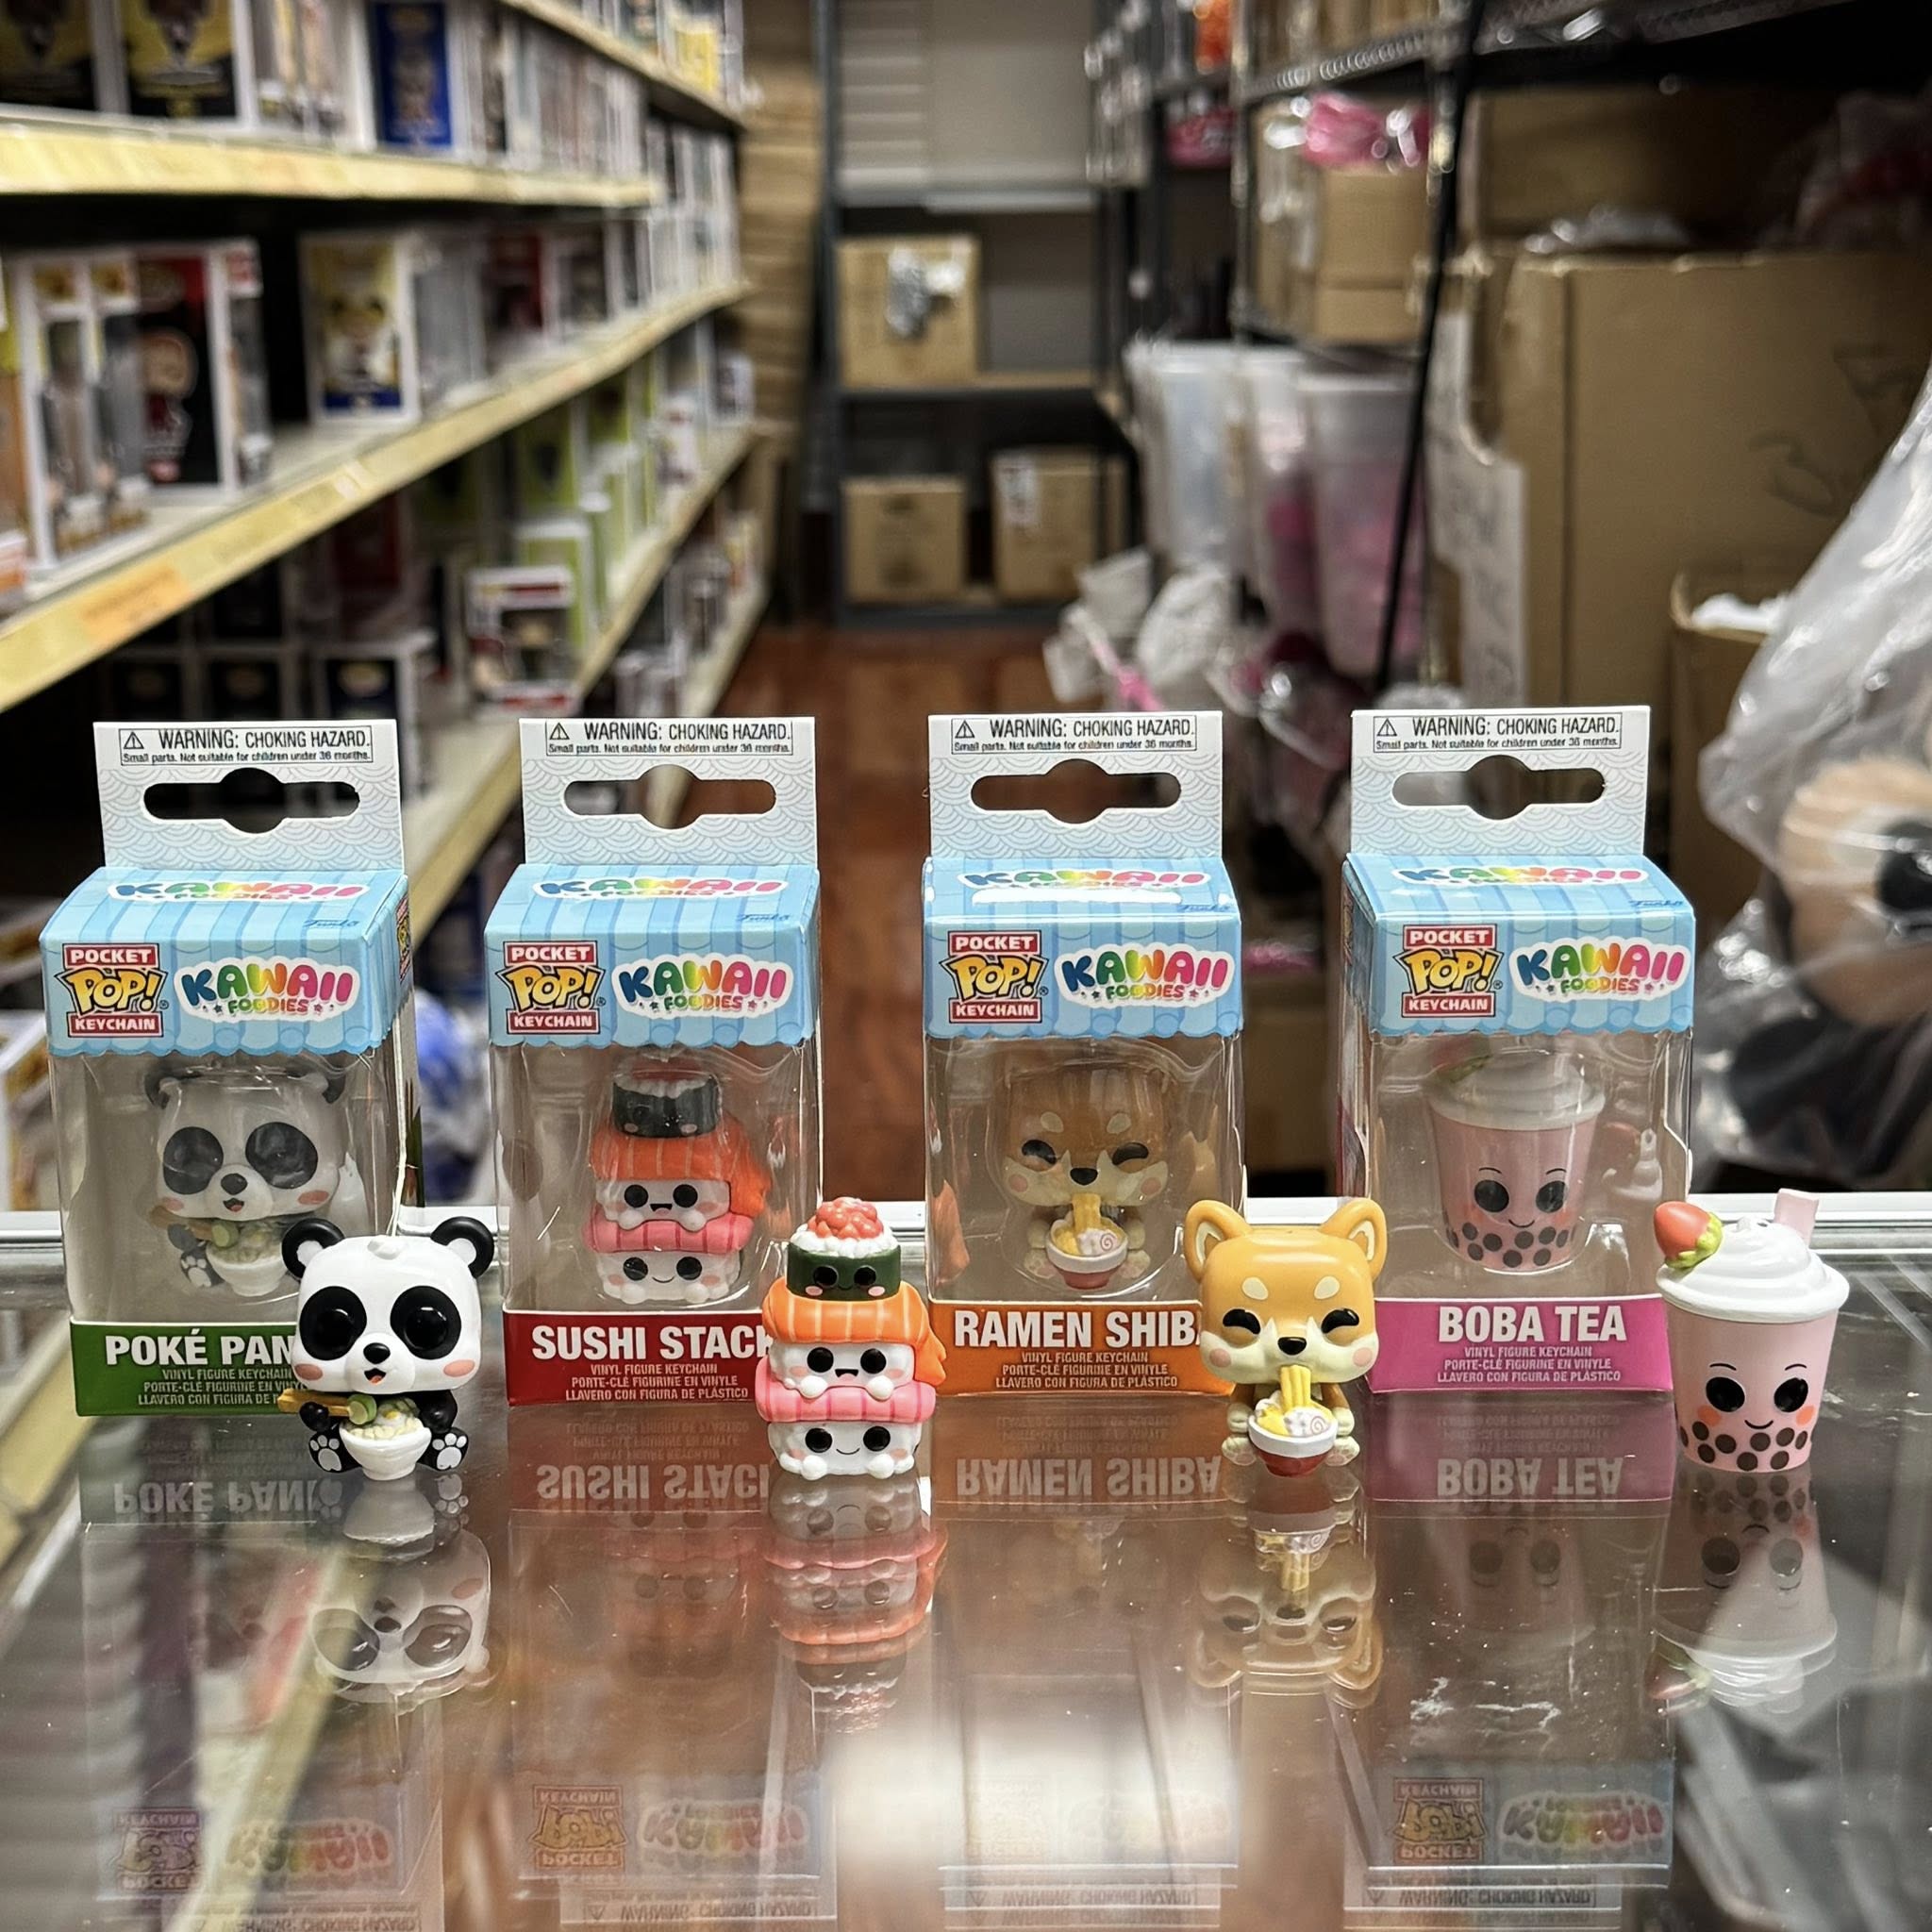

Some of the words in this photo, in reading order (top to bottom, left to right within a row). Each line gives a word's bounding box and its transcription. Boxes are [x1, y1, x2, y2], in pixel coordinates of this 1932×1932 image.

[584, 722, 661, 740] WARNING:
[669, 724, 728, 740] CHOKING
[733, 724, 791, 740] HAZARD.
[990, 718, 1066, 738] WARNING:
[1074, 720, 1132, 736] CHOKING
[1138, 719, 1194, 736] HAZARD.
[1412, 717, 1490, 736] WARNING:
[1497, 718, 1557, 735] CHOKING
[1561, 717, 1619, 733] HAZARD.
[158, 729, 238, 749] WARNING:
[245, 731, 306, 748] CHOKING
[311, 730, 370, 747] HAZARD.
[1376, 741, 1401, 749] Small
[1404, 740, 1428, 750] parts.
[1431, 740, 1446, 749] Not
[1487, 739, 1498, 747] for
[1541, 738, 1566, 746] under
[549, 743, 574, 753] Small
[576, 744, 601, 755] parts.
[605, 743, 619, 753] Not
[659, 743, 671, 753] for
[712, 743, 738, 753] under
[955, 742, 979, 751] Small
[982, 742, 1006, 752] parts.
[1009, 741, 1024, 750] Not
[1064, 741, 1075, 749] for
[1117, 741, 1141, 749] under
[124, 754, 148, 762] Small
[152, 754, 176, 764] parts.
[180, 753, 195, 761] Not
[237, 752, 248, 760] for
[291, 752, 316, 760] under
[965, 871, 1204, 885] KAWAII
[1399, 868, 1641, 880] KAWAII
[116, 882, 362, 895] KAWAII
[541, 878, 782, 893] KAWAII
[956, 936, 1033, 950] POCKET
[1409, 930, 1490, 944] POCKET
[71, 949, 151, 964] POCKET
[511, 946, 590, 960] POCKET
[1060, 950, 1227, 990] KAWAII
[1517, 942, 1685, 985] KAWAII
[181, 963, 353, 1006] KAWAII
[619, 959, 786, 1003] KAWAII
[1560, 978, 1641, 994] FOODIES
[1106, 984, 1186, 1001] FOODIES
[228, 996, 308, 1013] FOODIES
[664, 993, 743, 1011] FOODIES
[1408, 998, 1488, 1012] KEYCHAIN
[956, 1004, 1035, 1017] KEYCHAIN
[75, 1016, 156, 1030] KEYCHAIN
[514, 1014, 591, 1027] KEYCHAIN
[955, 1310, 1091, 1347] RAMEN
[1106, 1310, 1200, 1348] SHIB
[1439, 1306, 1544, 1342] BOBA
[1556, 1306, 1626, 1341] TEA
[105, 1328, 208, 1365] POKÉ
[221, 1336, 295, 1364] PAN
[532, 1325, 646, 1360] SUSHI
[1022, 1352, 1052, 1363] VINYL
[1056, 1352, 1092, 1363] FIGURE
[1096, 1352, 1148, 1362] KEYCHAIN
[1464, 1346, 1494, 1357] VINYL
[1498, 1346, 1535, 1357] FIGURE
[1540, 1346, 1591, 1357] KEYCHAIN
[591, 1364, 622, 1375] VINYL
[625, 1364, 661, 1374] FIGURE
[665, 1364, 717, 1374] KEYCHAIN
[1063, 1364, 1111, 1375] FIGURINE
[1115, 1364, 1128, 1374] EN
[1131, 1364, 1168, 1374] VINYLE
[1506, 1358, 1554, 1370] FIGURINE
[1557, 1358, 1571, 1369] EN
[1574, 1358, 1610, 1369] VINYLE
[162, 1369, 194, 1379] VINYL
[197, 1369, 235, 1379] FIGURE
[239, 1369, 291, 1379] KEYCHAIN
[632, 1376, 680, 1387] FIGURINE
[684, 1376, 698, 1387] EN
[701, 1375, 738, 1386] VINYLE
[1438, 1372, 1483, 1382] LLAVERO
[1487, 1372, 1507, 1382] CON
[1512, 1372, 1550, 1382] FIGURA
[1554, 1372, 1566, 1382] DE
[1571, 1370, 1621, 1381] PLÁSTICO
[206, 1381, 255, 1392] FIGURINE
[258, 1381, 272, 1391] EN
[996, 1377, 1041, 1388] LLAVERO
[1045, 1377, 1066, 1388] CON
[1070, 1377, 1107, 1388] FIGURA
[1111, 1377, 1124, 1388] DE
[1128, 1375, 1177, 1387] PLÁSTICO
[139, 1394, 184, 1405] LLAVERO
[189, 1394, 209, 1405] CON
[214, 1394, 252, 1405] FIGURA
[256, 1394, 270, 1405] DE
[566, 1390, 611, 1401] LLAVERO
[615, 1390, 636, 1400] CON
[641, 1389, 677, 1400] FIGURA
[682, 1389, 695, 1399] DE
[699, 1387, 748, 1398] PLÁSTICO
